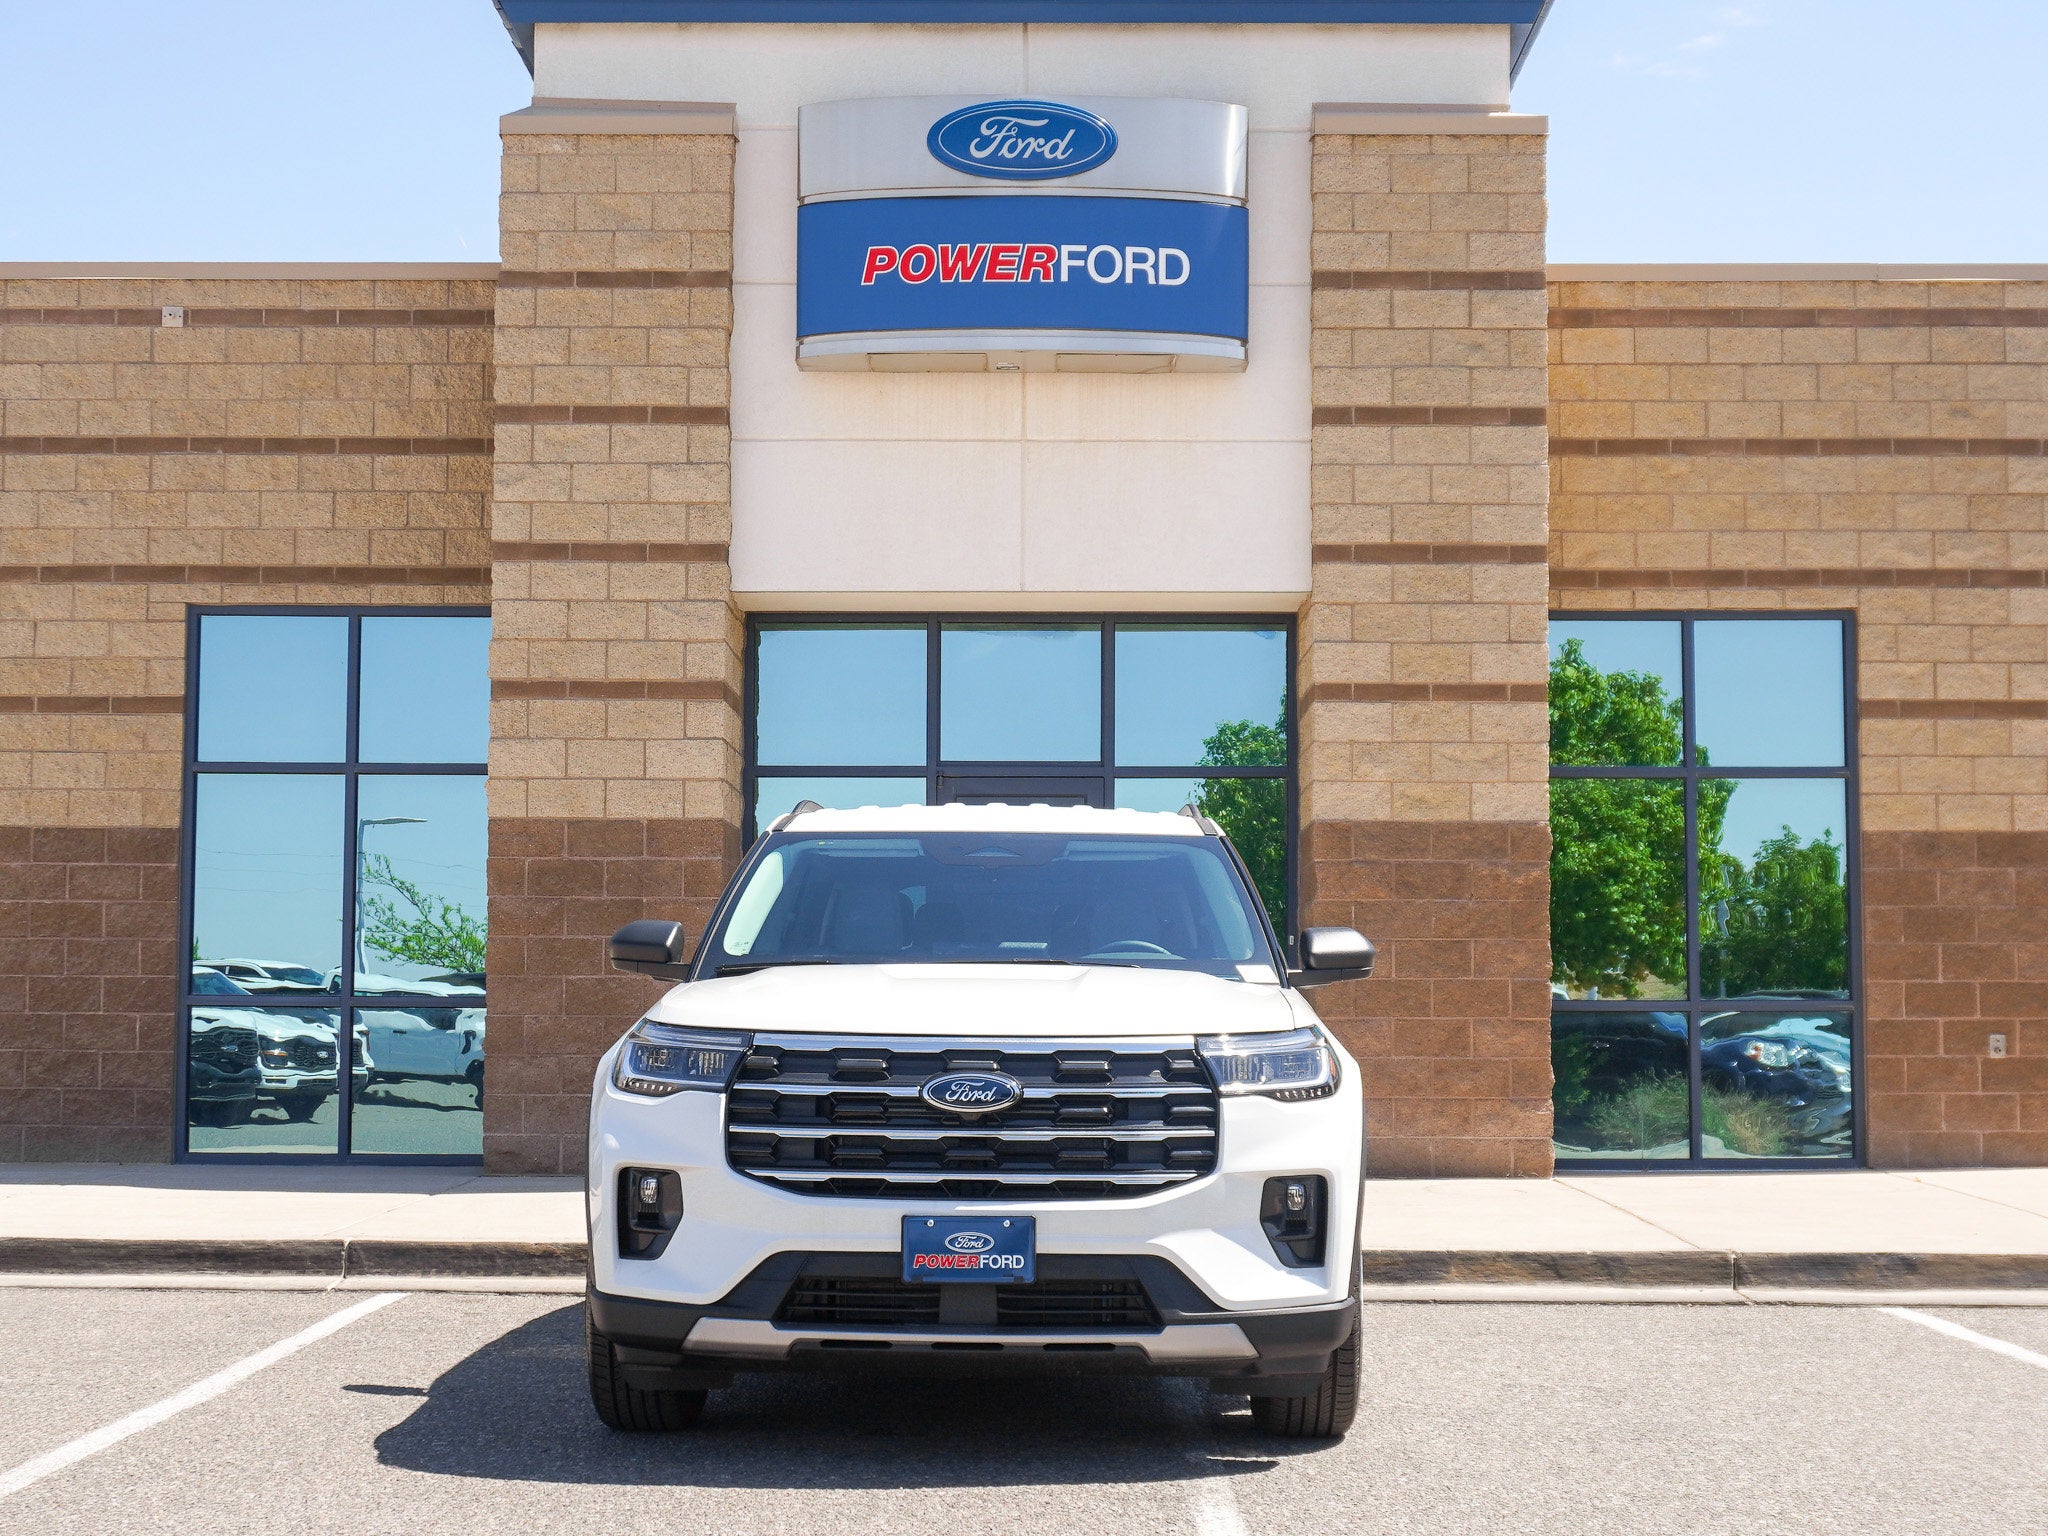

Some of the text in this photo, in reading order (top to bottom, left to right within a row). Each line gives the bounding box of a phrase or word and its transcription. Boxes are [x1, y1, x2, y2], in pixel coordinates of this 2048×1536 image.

[969, 116, 1076, 161] Ford
[945, 1080, 998, 1102] Ford
[954, 1235, 985, 1249] Ford
